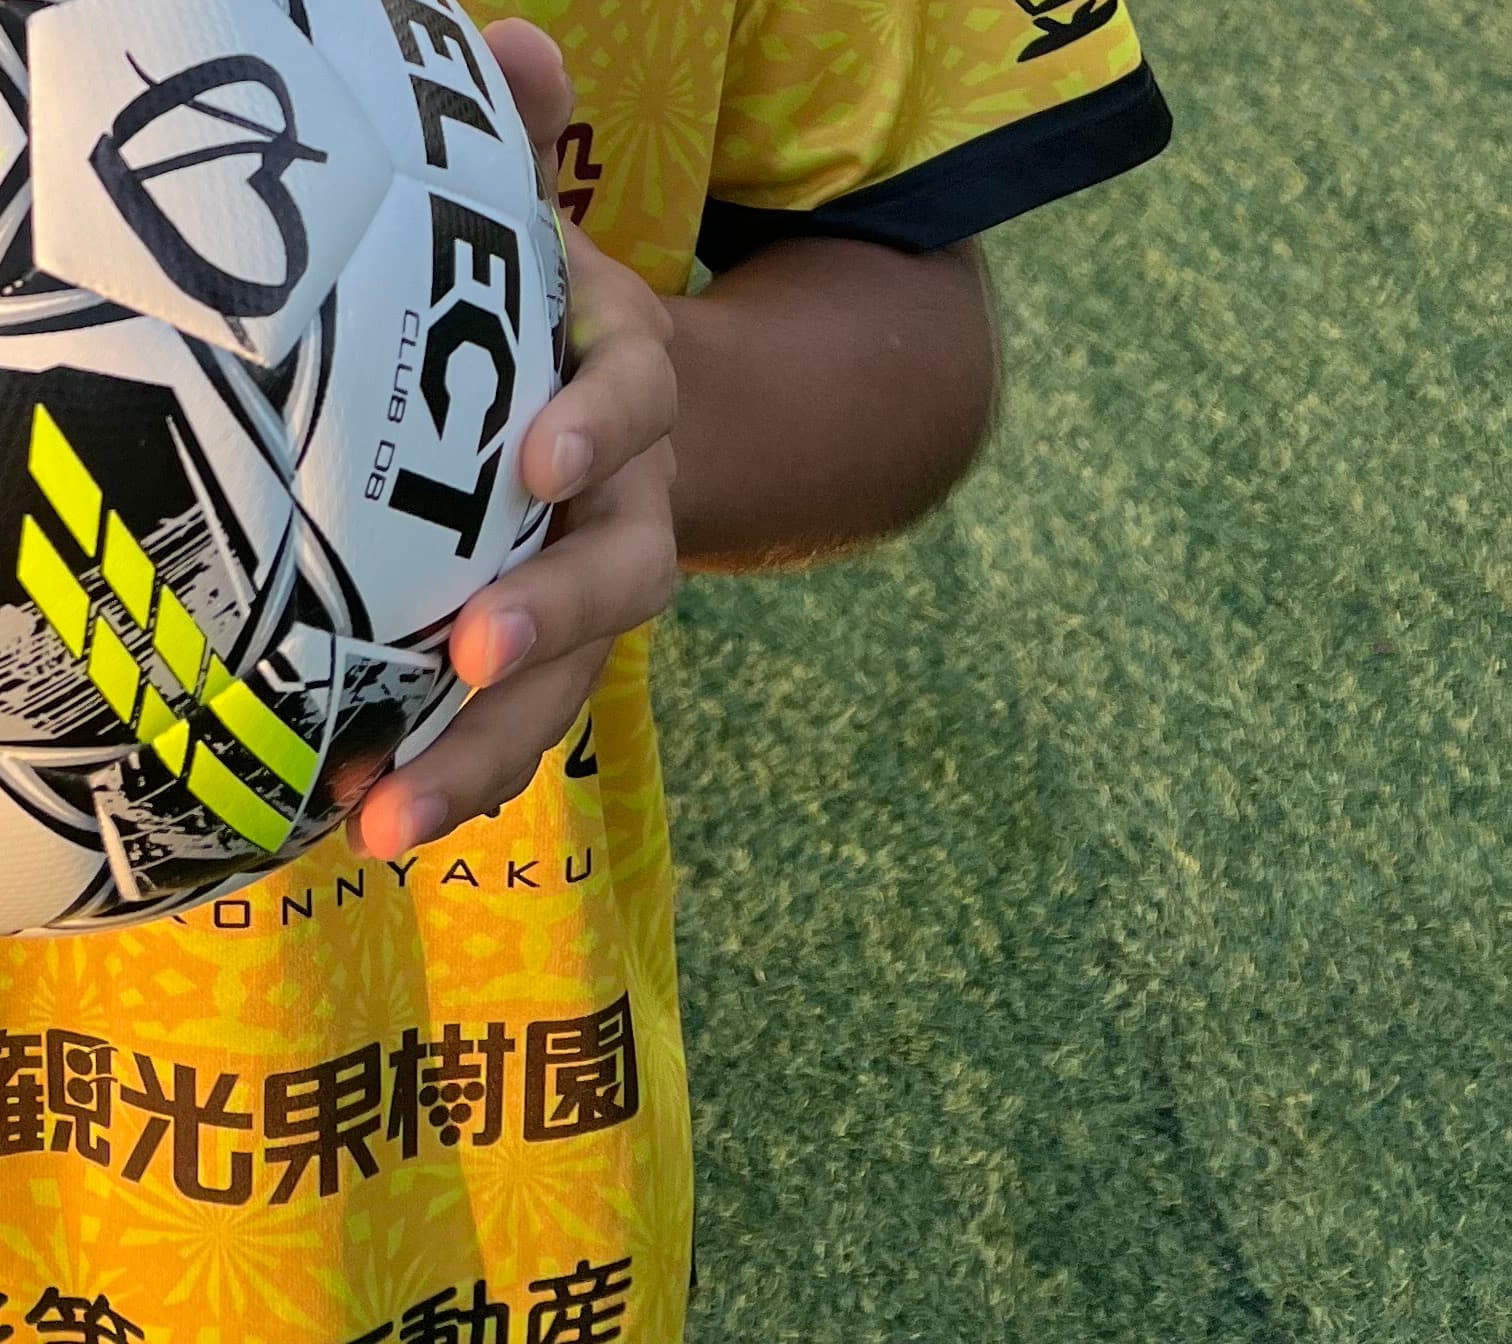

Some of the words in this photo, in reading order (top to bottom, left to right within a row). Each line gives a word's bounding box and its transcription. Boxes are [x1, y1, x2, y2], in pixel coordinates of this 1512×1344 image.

[387, 309, 420, 424] CLUB
[364, 437, 397, 502] DB
[168, 846, 593, 930] ONNYAKU
